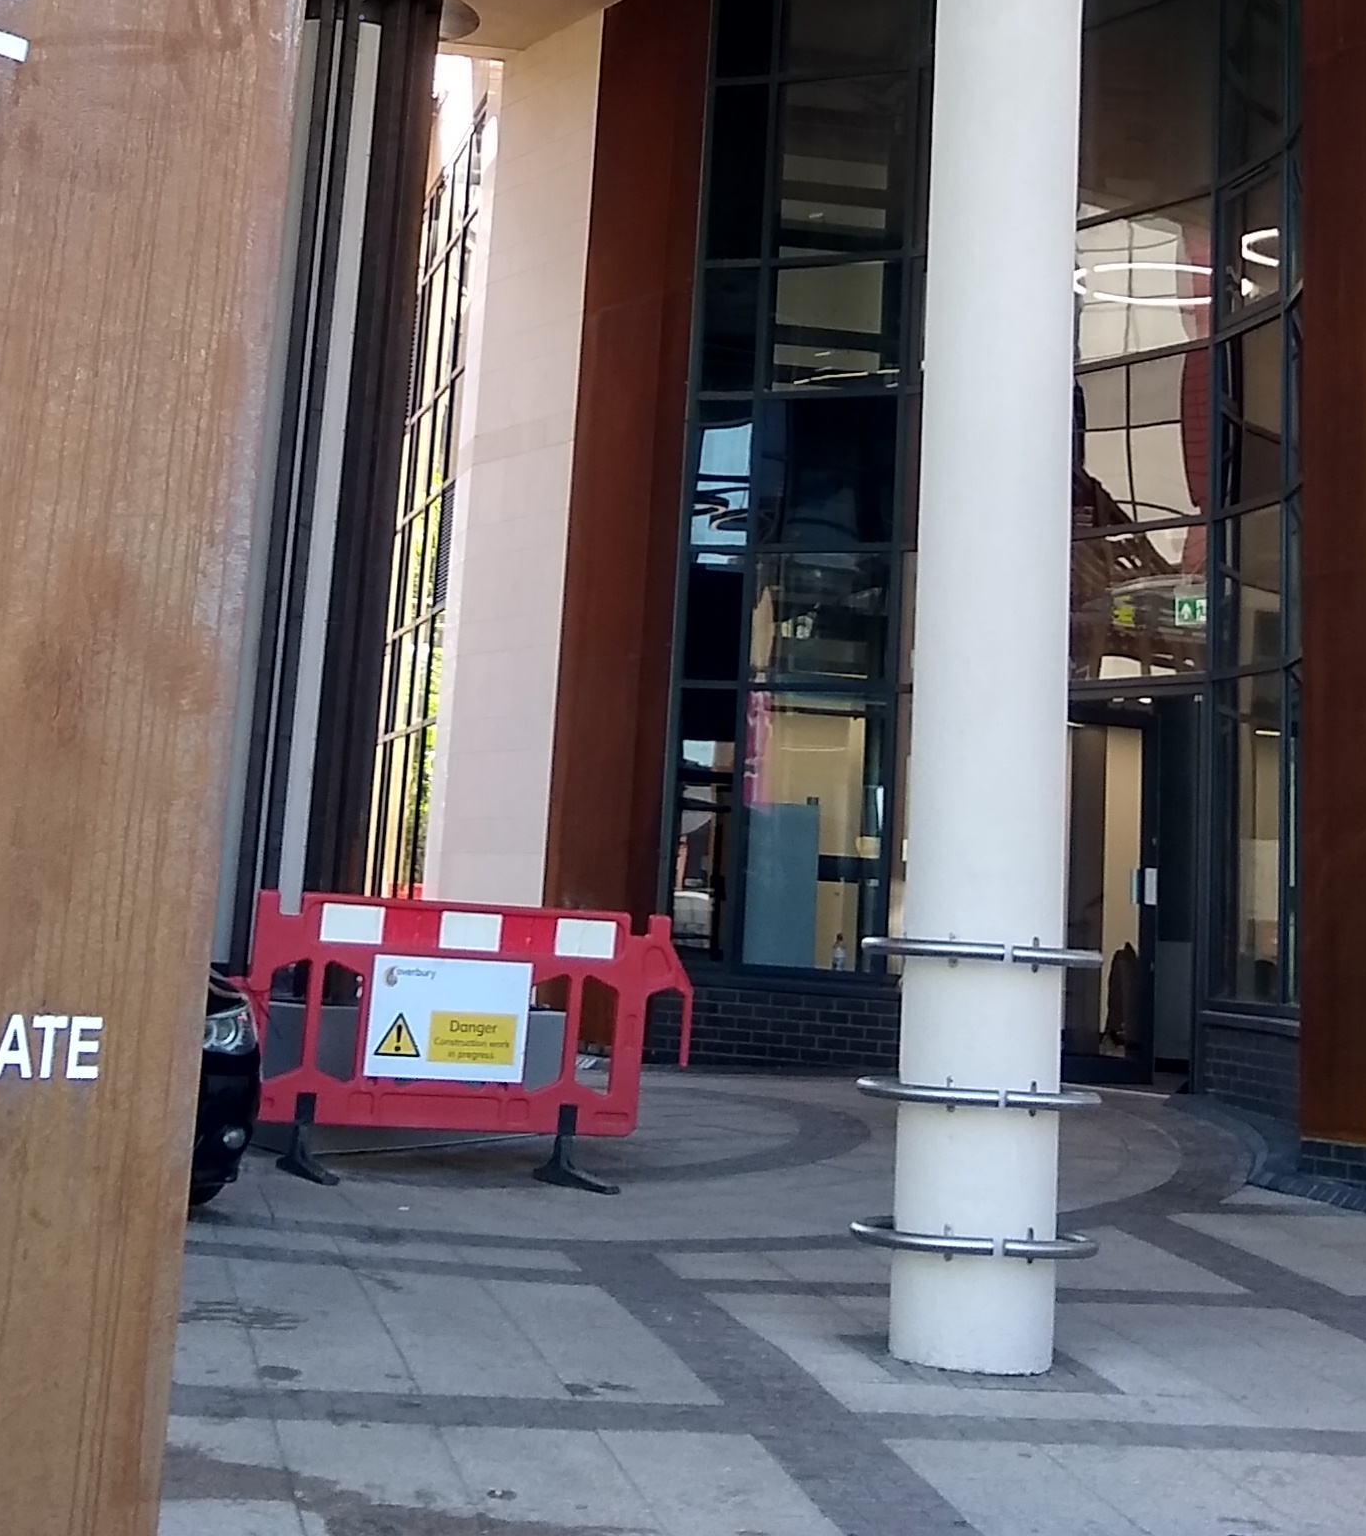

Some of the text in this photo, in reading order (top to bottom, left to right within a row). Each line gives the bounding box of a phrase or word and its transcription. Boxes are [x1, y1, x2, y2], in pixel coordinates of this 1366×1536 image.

[396, 965, 437, 980] overbury
[449, 1019, 498, 1037] Danger
[433, 1035, 511, 1049] Construction work
[457, 1050, 495, 1061] progress
